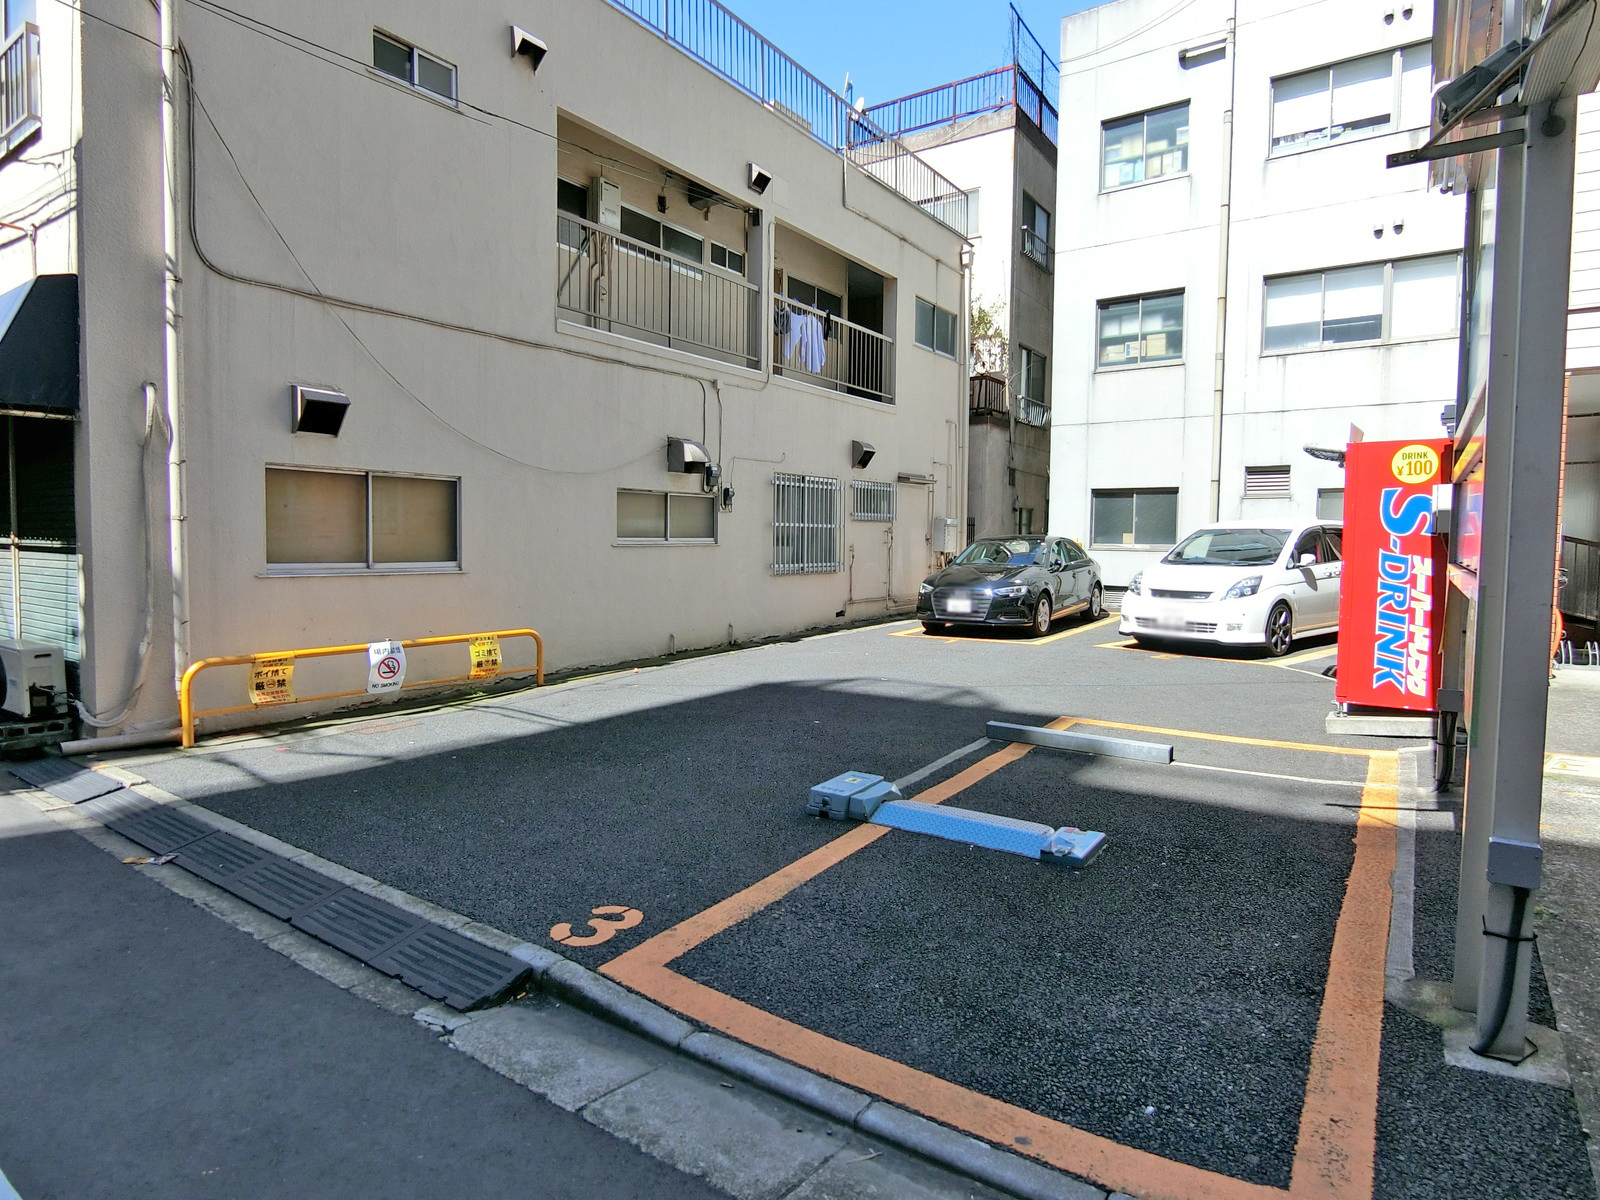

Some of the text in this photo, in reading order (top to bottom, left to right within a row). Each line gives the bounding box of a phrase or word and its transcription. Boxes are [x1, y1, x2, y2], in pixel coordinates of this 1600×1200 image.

[1397, 460, 1433, 476] ¥100
[1402, 452, 1428, 460] DRINK
[1373, 487, 1437, 694] S-DRINK
[1406, 554, 1433, 697] スーパードリンク
[550, 905, 644, 947] 3
